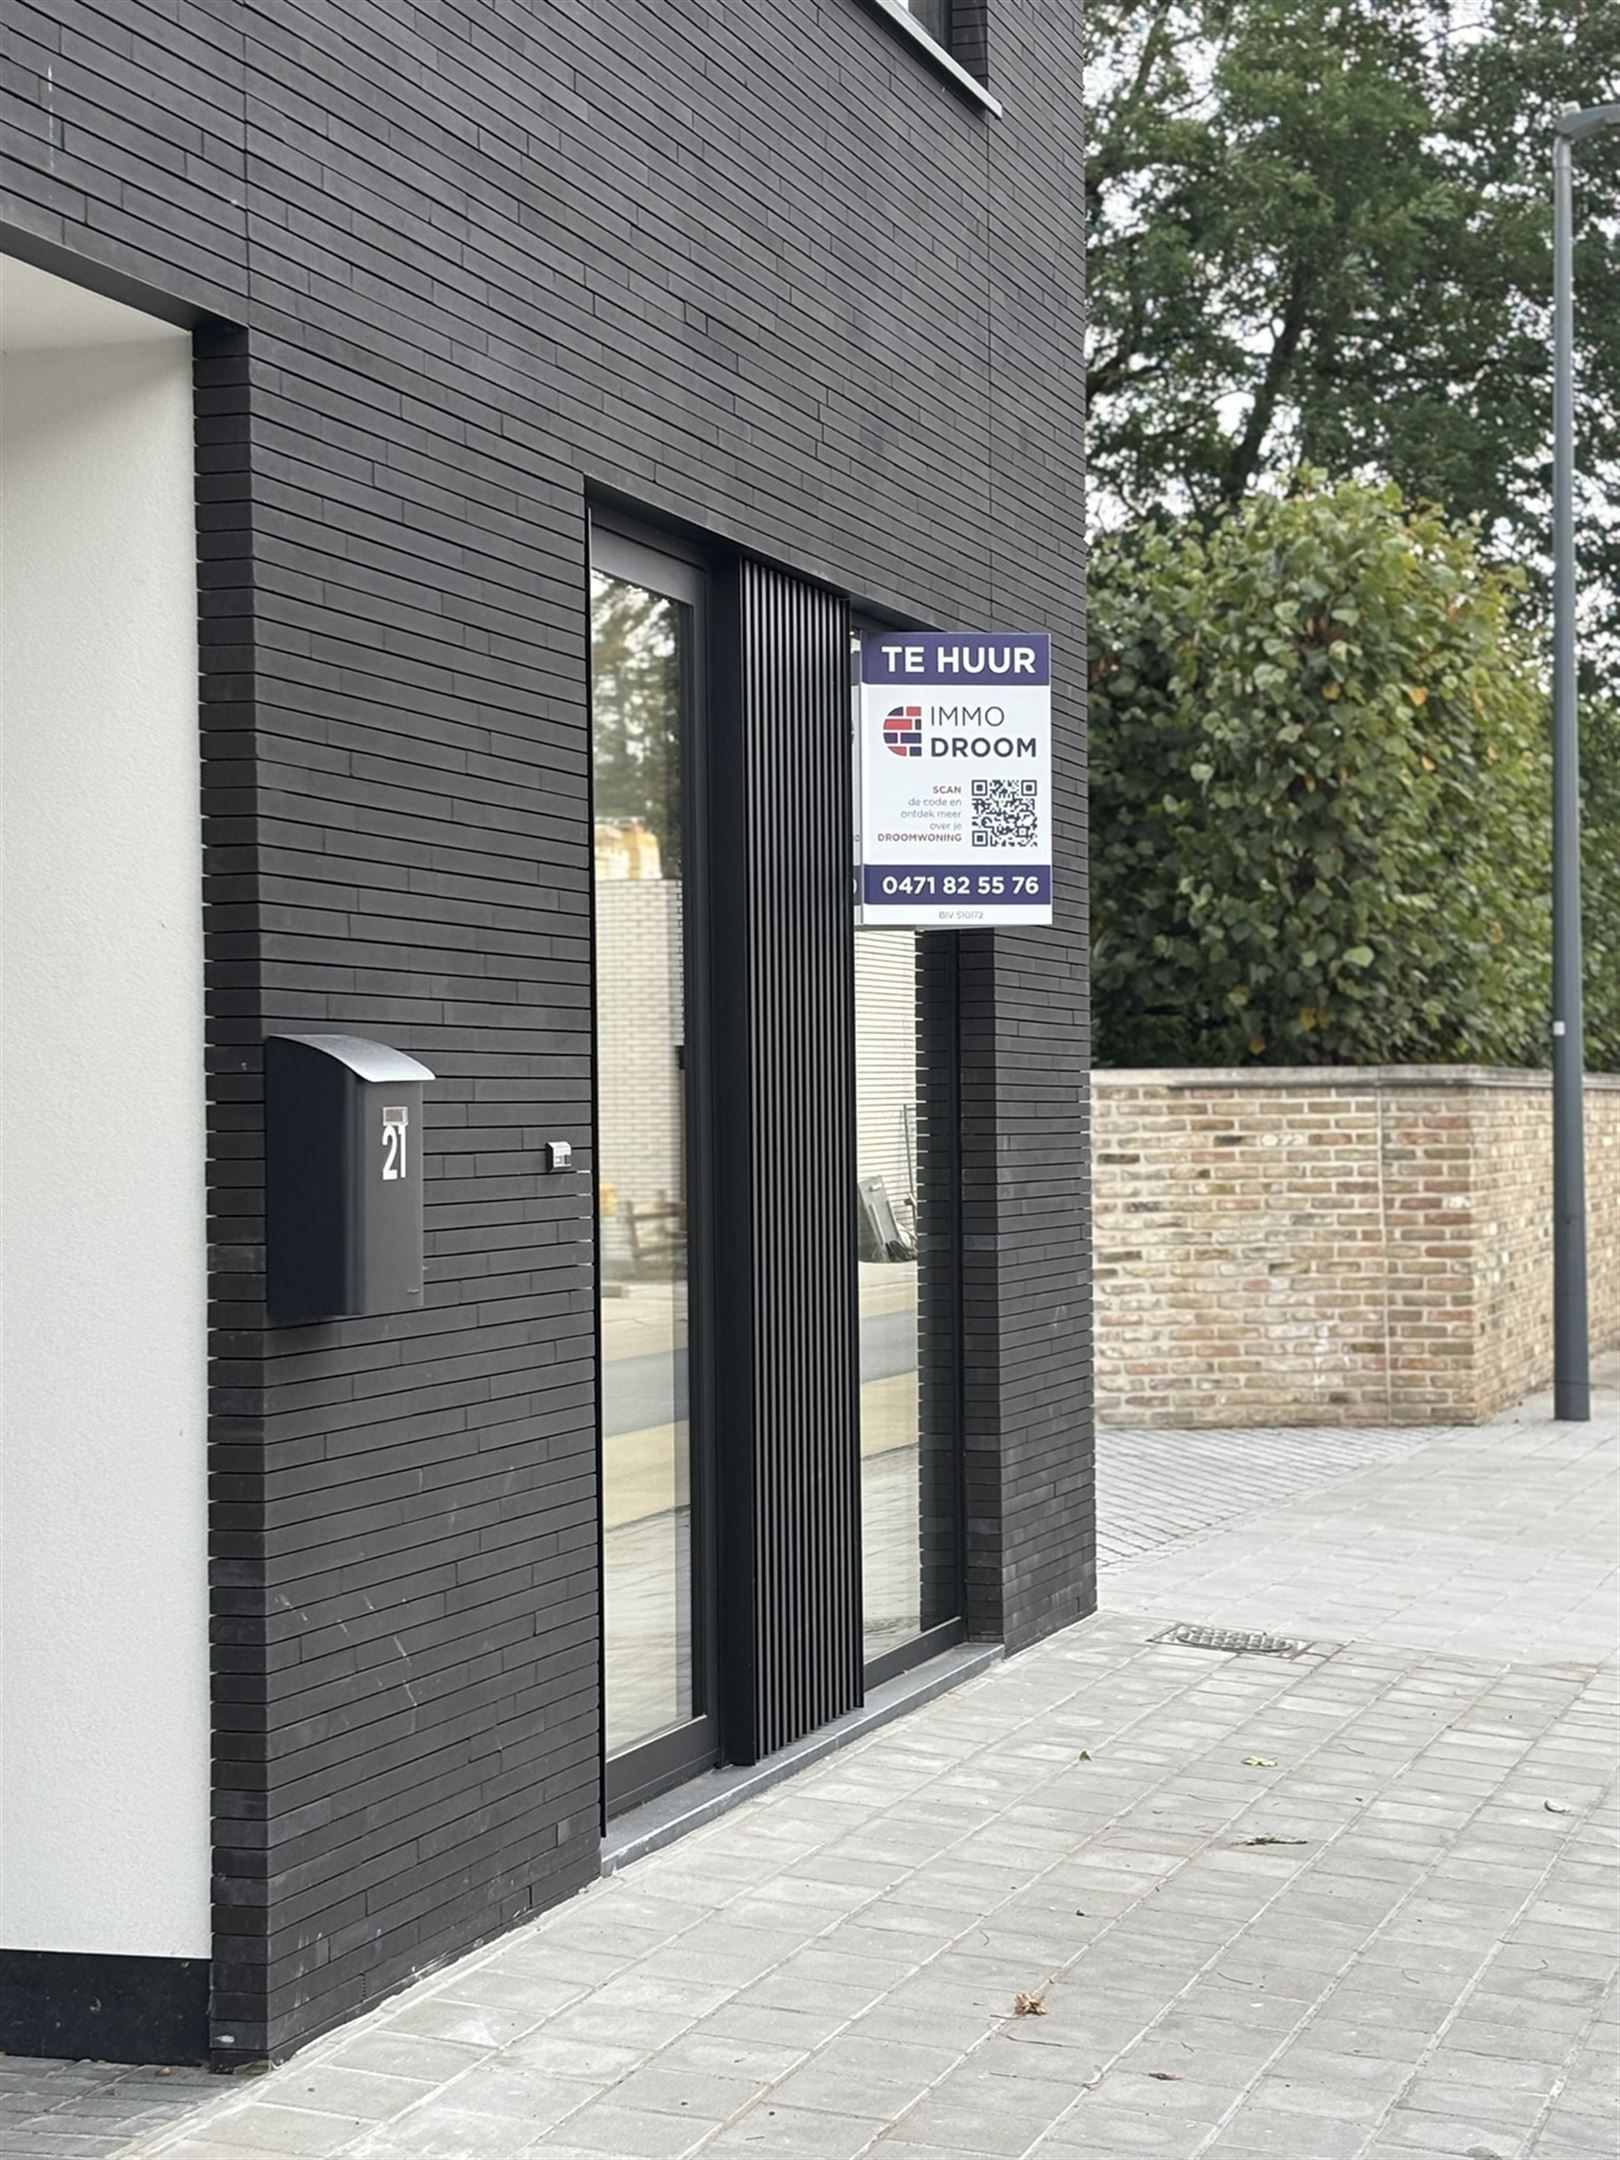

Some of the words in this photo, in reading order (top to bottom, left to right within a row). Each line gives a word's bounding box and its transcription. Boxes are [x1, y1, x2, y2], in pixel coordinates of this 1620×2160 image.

[881, 646, 925, 673] TE
[937, 646, 1036, 674] HUUR
[931, 706, 1005, 727] IMMO
[931, 737, 1036, 758] DROOM
[932, 785, 962, 794] SCAN
[907, 797, 921, 807] de
[922, 797, 948, 807] code
[949, 799, 962, 807] en
[900, 809, 935, 818] ontdek
[929, 822, 951, 830] over
[953, 821, 962, 831] je
[877, 833, 962, 842] DROOMWONING
[882, 876, 935, 895] 0471
[943, 876, 970, 895] 82
[977, 876, 1005, 895] 55
[1012, 876, 1039, 895] 76
[382, 1125, 406, 1180] 21
